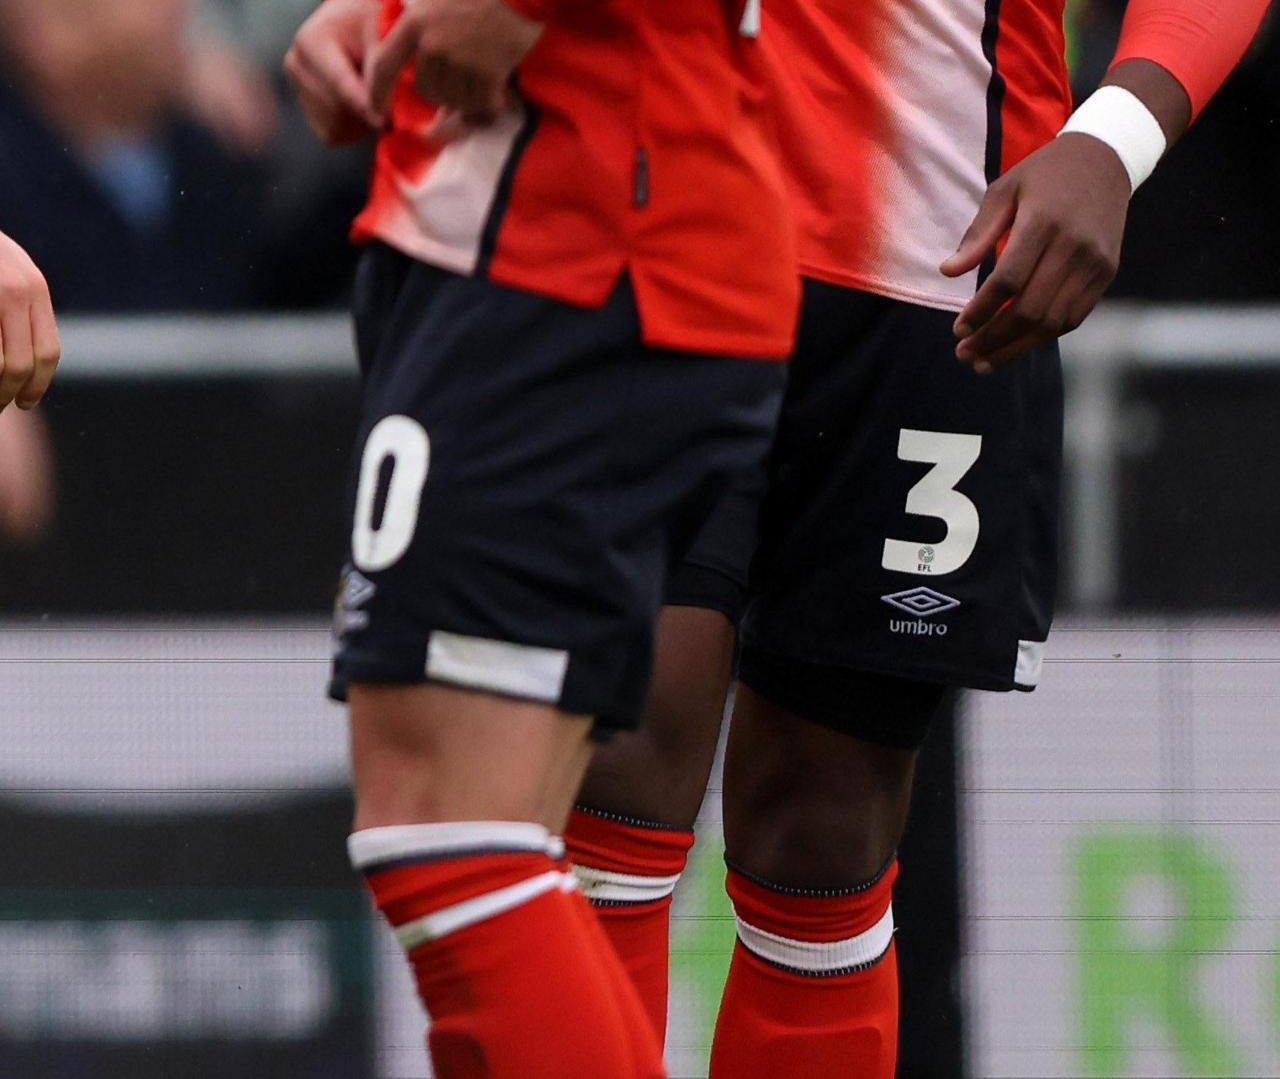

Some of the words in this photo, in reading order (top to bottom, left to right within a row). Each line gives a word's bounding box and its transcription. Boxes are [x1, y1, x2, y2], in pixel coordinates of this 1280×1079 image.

[351, 414, 431, 573] 0
[881, 428, 983, 576] 3
[889, 619, 948, 636] umbro
[917, 563, 932, 573] EFL
[1072, 825, 1280, 1079] R
